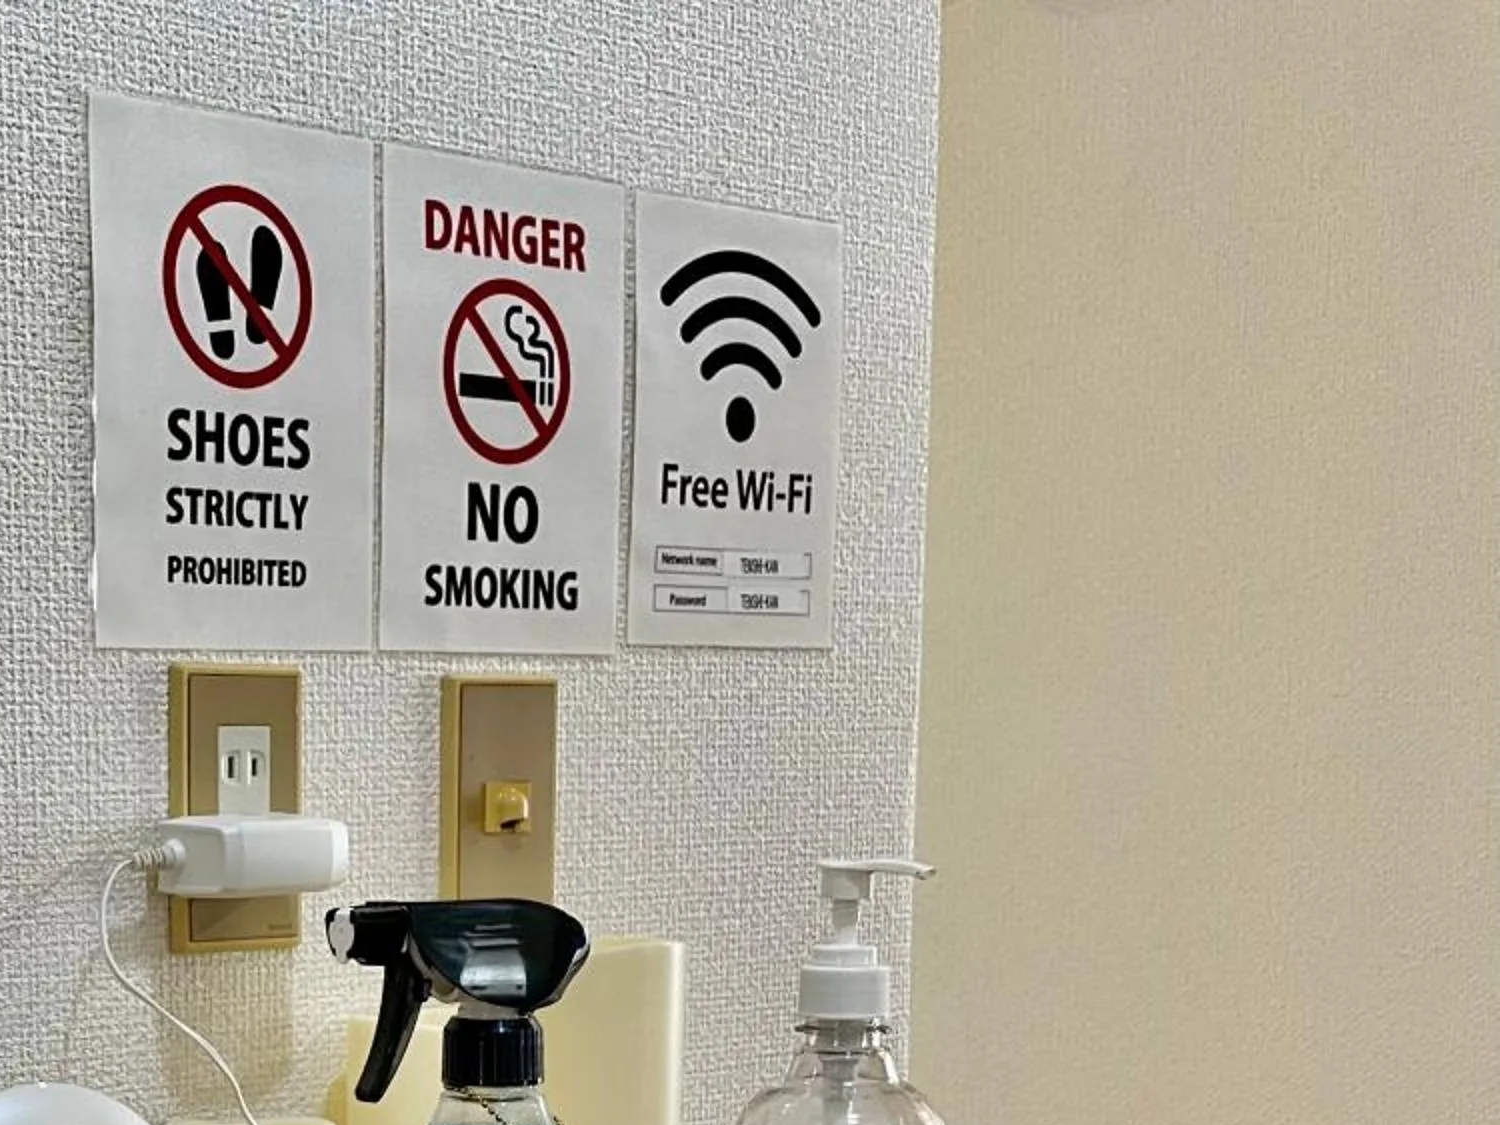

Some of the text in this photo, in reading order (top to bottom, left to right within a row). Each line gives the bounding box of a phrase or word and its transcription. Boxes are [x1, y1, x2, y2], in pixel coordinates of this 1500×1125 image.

[424, 199, 587, 273] DANGER
[167, 408, 312, 470] SHOES
[165, 487, 309, 531] STRICTLY
[467, 483, 540, 545] NO
[662, 464, 813, 515] Free Wi-Fi
[167, 555, 308, 588] PROHIBITED
[661, 552, 694, 565] Network
[424, 564, 579, 613] SMOKING
